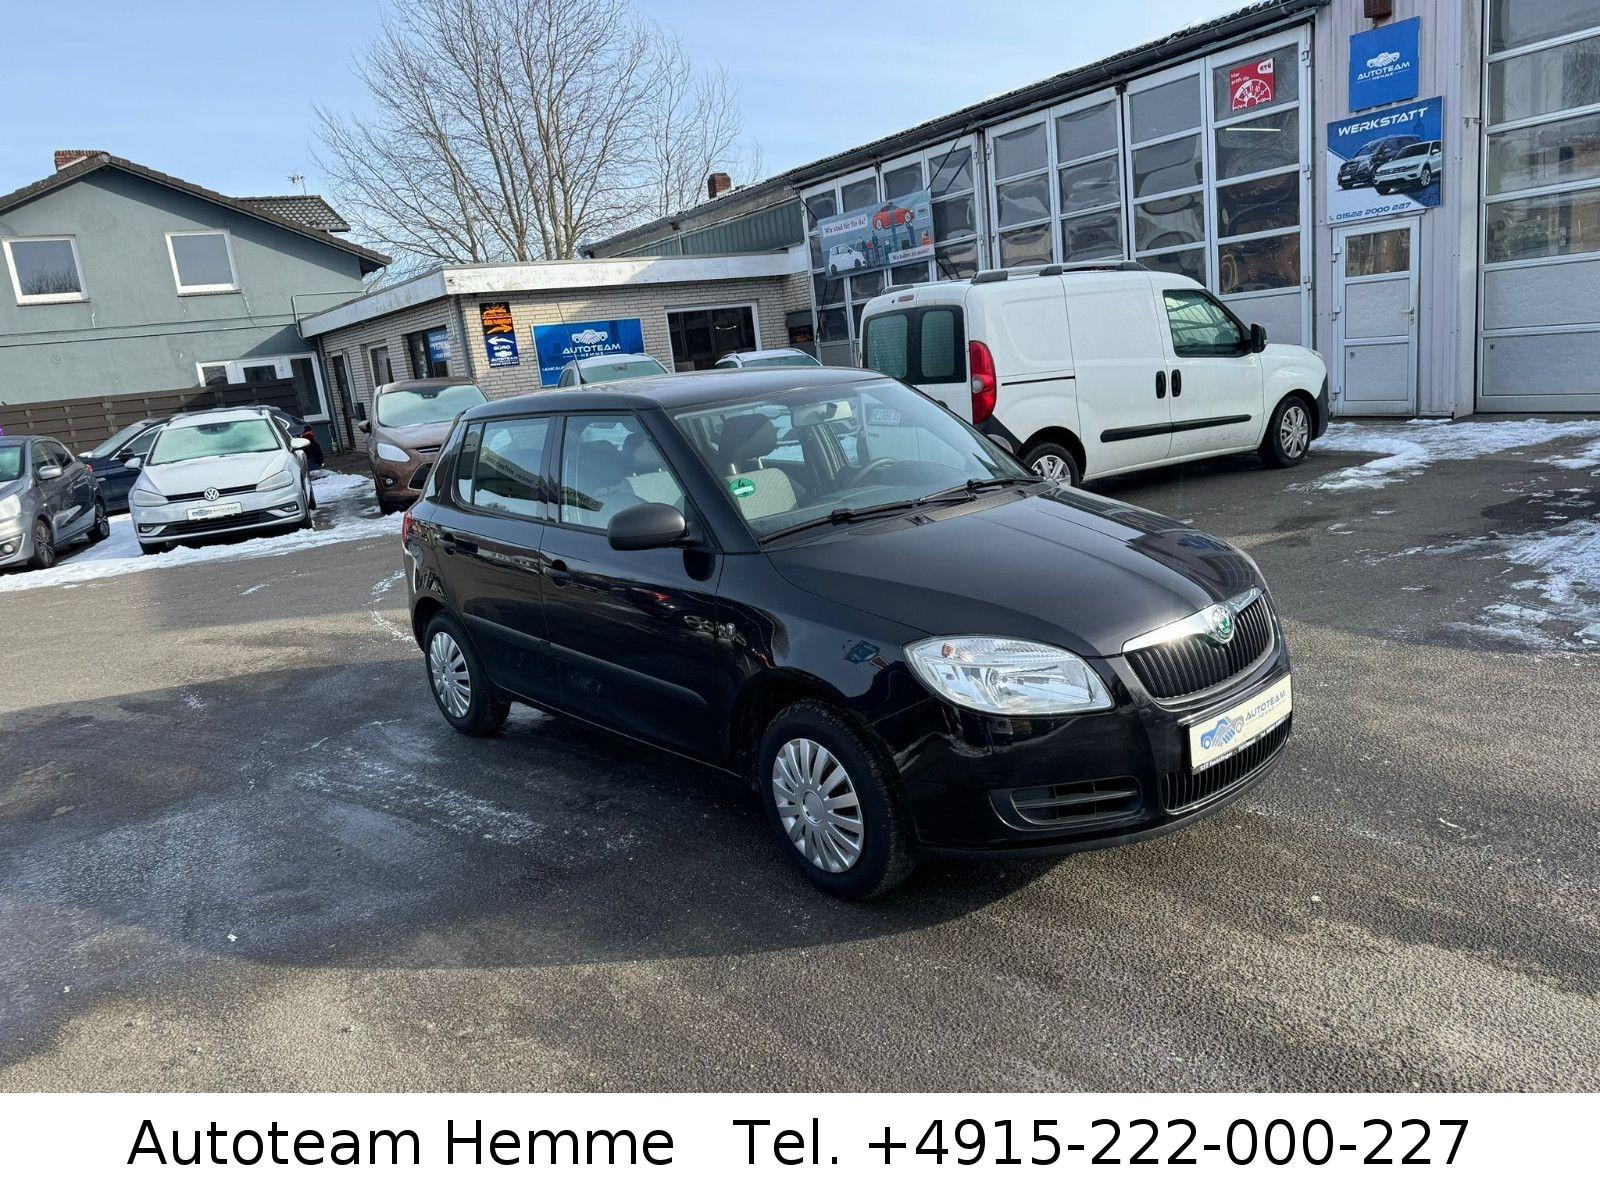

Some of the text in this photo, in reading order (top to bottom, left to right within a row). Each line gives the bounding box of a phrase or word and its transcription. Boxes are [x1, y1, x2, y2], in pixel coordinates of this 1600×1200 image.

[1357, 61, 1410, 80] AUTOTEAM
[1337, 106, 1429, 137] WERKSTATT
[1336, 201, 1412, 221] 01522 2000 227
[562, 343, 621, 355] AUTOTEAM
[1245, 690, 1286, 721] AUTOTEAM
